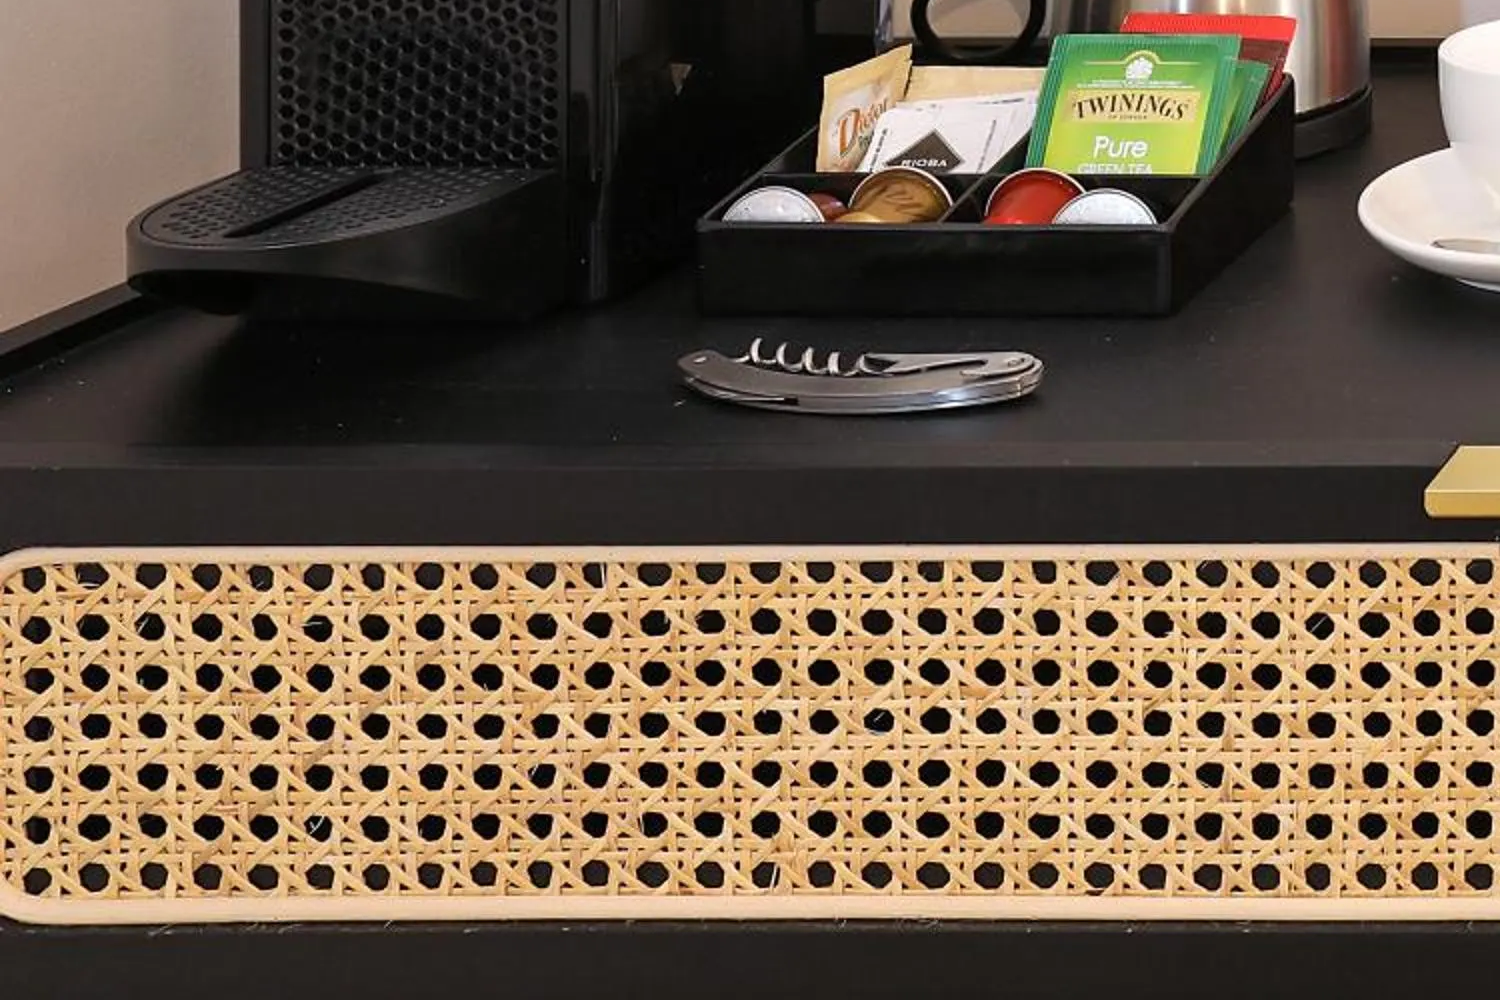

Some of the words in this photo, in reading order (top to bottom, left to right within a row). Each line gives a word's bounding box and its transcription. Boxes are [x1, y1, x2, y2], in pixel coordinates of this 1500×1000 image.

[1073, 93, 1185, 119] TWININGS
[1093, 135, 1148, 158] Pure
[901, 159, 947, 167] RIOBA
